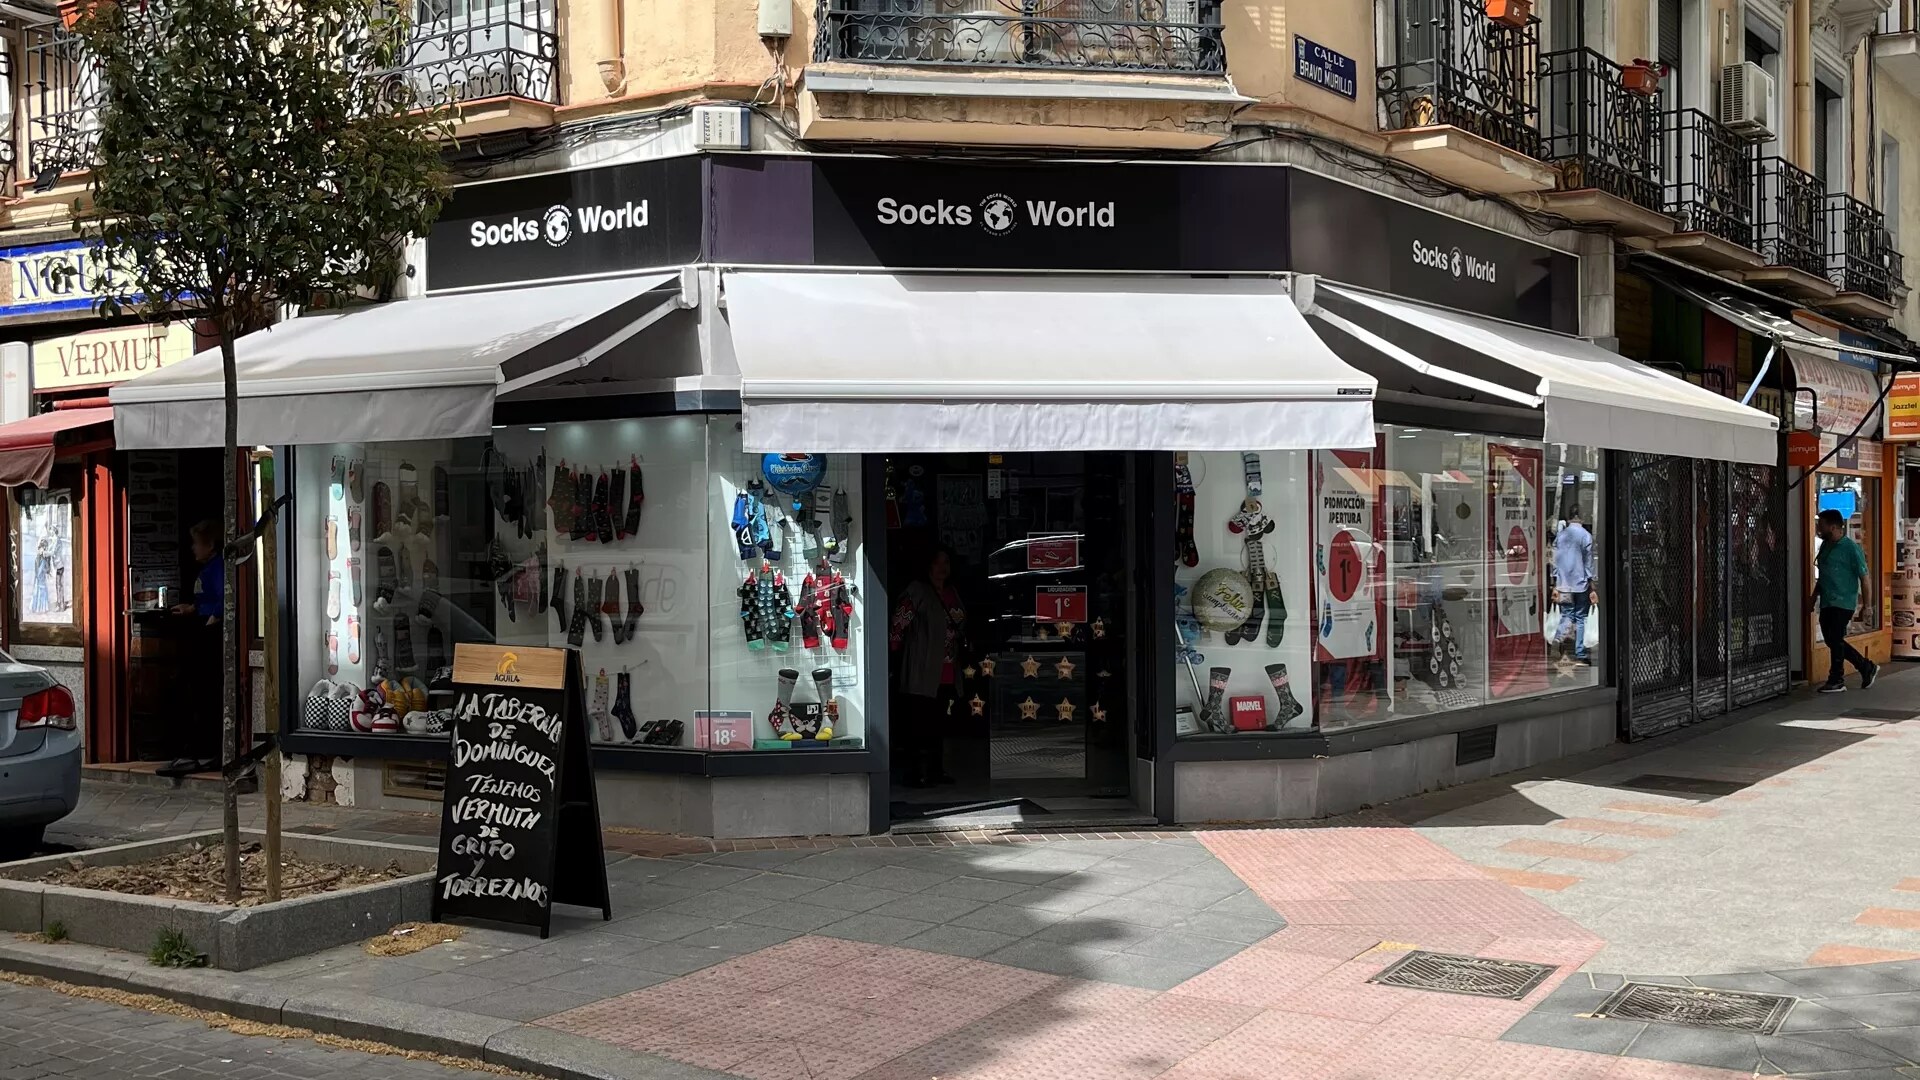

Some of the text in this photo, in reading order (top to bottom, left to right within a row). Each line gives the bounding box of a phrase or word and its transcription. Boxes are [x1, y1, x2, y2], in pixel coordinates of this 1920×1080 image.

[1314, 46, 1345, 68] CALLE
[1324, 61, 1333, 71] DE
[1299, 59, 1353, 96] BRAVO MURILLO
[470, 216, 540, 248] Socks
[577, 199, 649, 234] World
[876, 197, 1115, 227] Socks World
[1412, 239, 1448, 271] Socks
[1465, 254, 1496, 283] World
[57, 335, 168, 378] VERMUT
[1892, 403, 1918, 411] Jazztel
[1214, 582, 1247, 612] Feliz
[453, 692, 563, 743] LA TABERNA
[1236, 700, 1263, 712] MARVEL
[487, 722, 517, 739] DE
[465, 773, 542, 802] TENEMOS
[451, 796, 542, 830] VERMUTH
[477, 825, 501, 838] DE
[451, 834, 516, 860] GRIFO
[470, 857, 486, 878] Y
[439, 872, 549, 908] TORREZNOS
